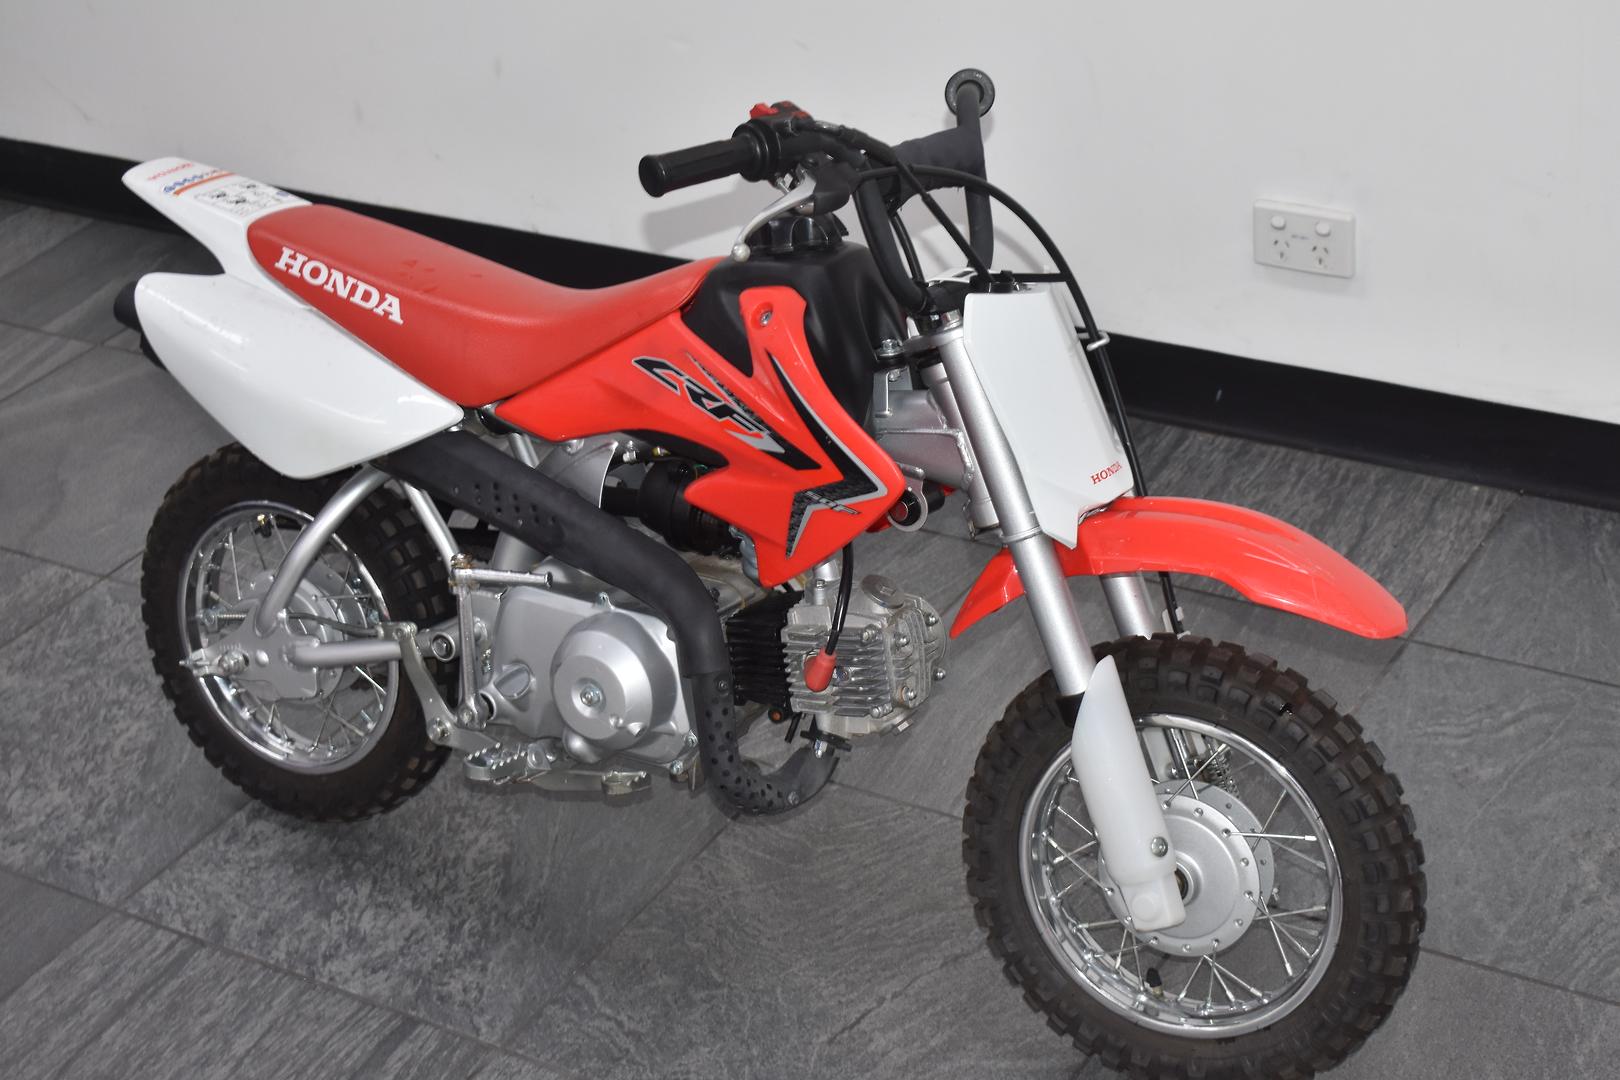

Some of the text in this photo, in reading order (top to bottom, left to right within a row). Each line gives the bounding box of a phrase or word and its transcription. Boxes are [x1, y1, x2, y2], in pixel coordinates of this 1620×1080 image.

[274, 246, 404, 325] HONDA
[632, 356, 770, 434] CRF
[1091, 461, 1122, 484] HONDA
